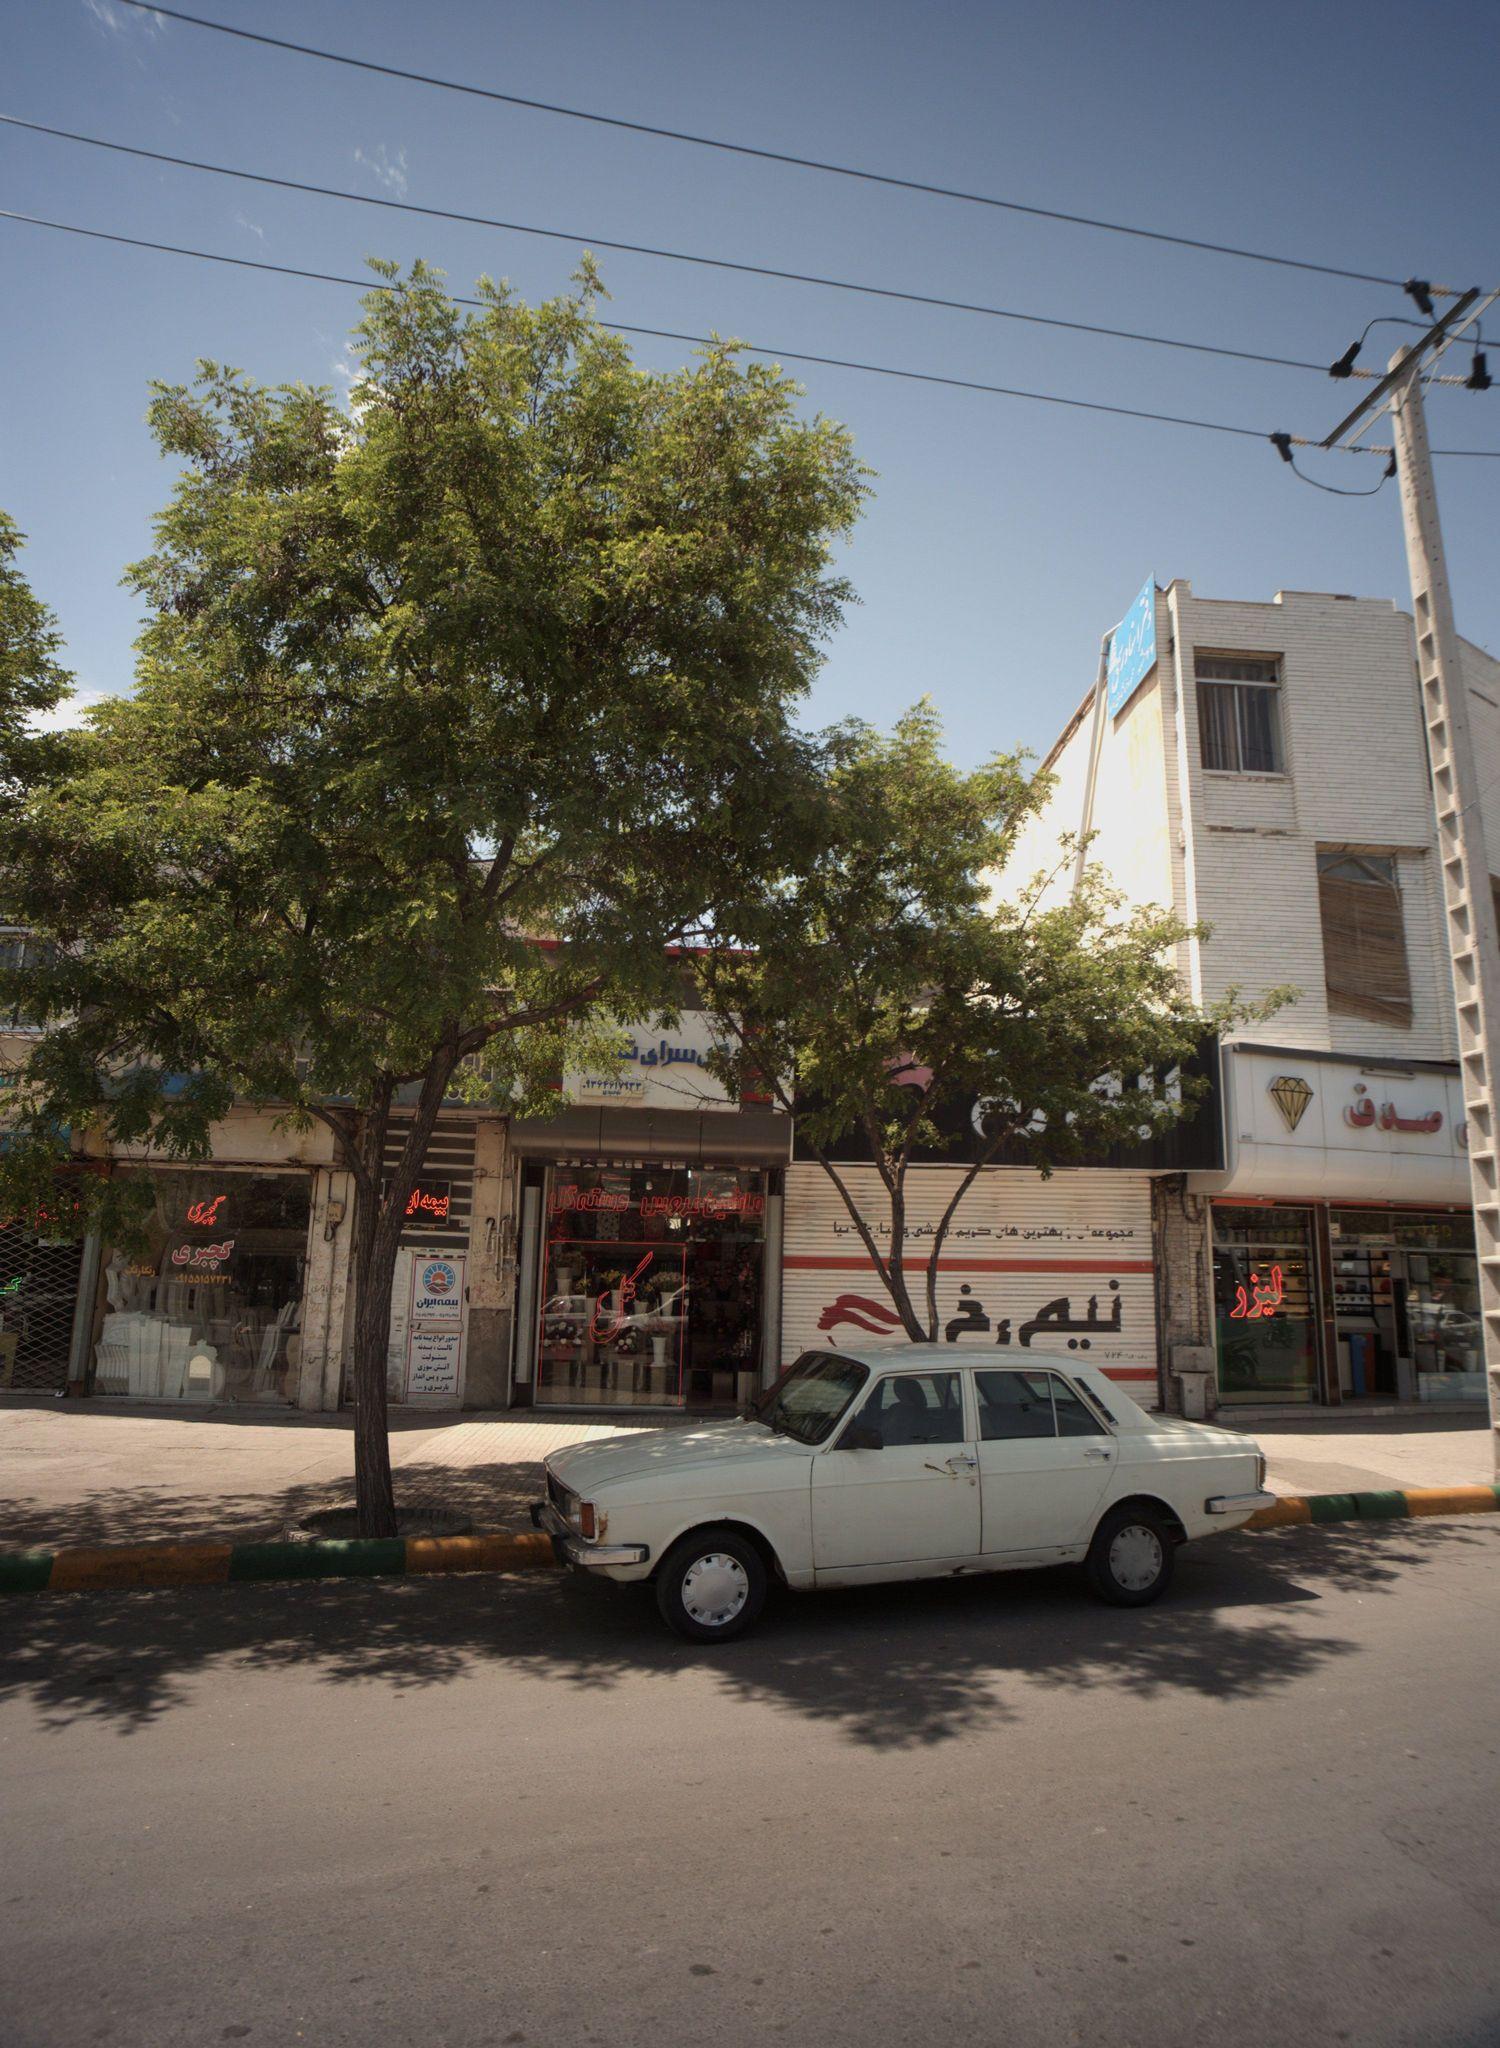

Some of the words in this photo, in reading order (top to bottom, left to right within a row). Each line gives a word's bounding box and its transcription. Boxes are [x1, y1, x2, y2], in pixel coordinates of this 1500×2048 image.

[1342, 1082, 1443, 1136] صدف
[172, 1240, 235, 1270] گچبری
[1230, 1265, 1283, 1318] لیزر
